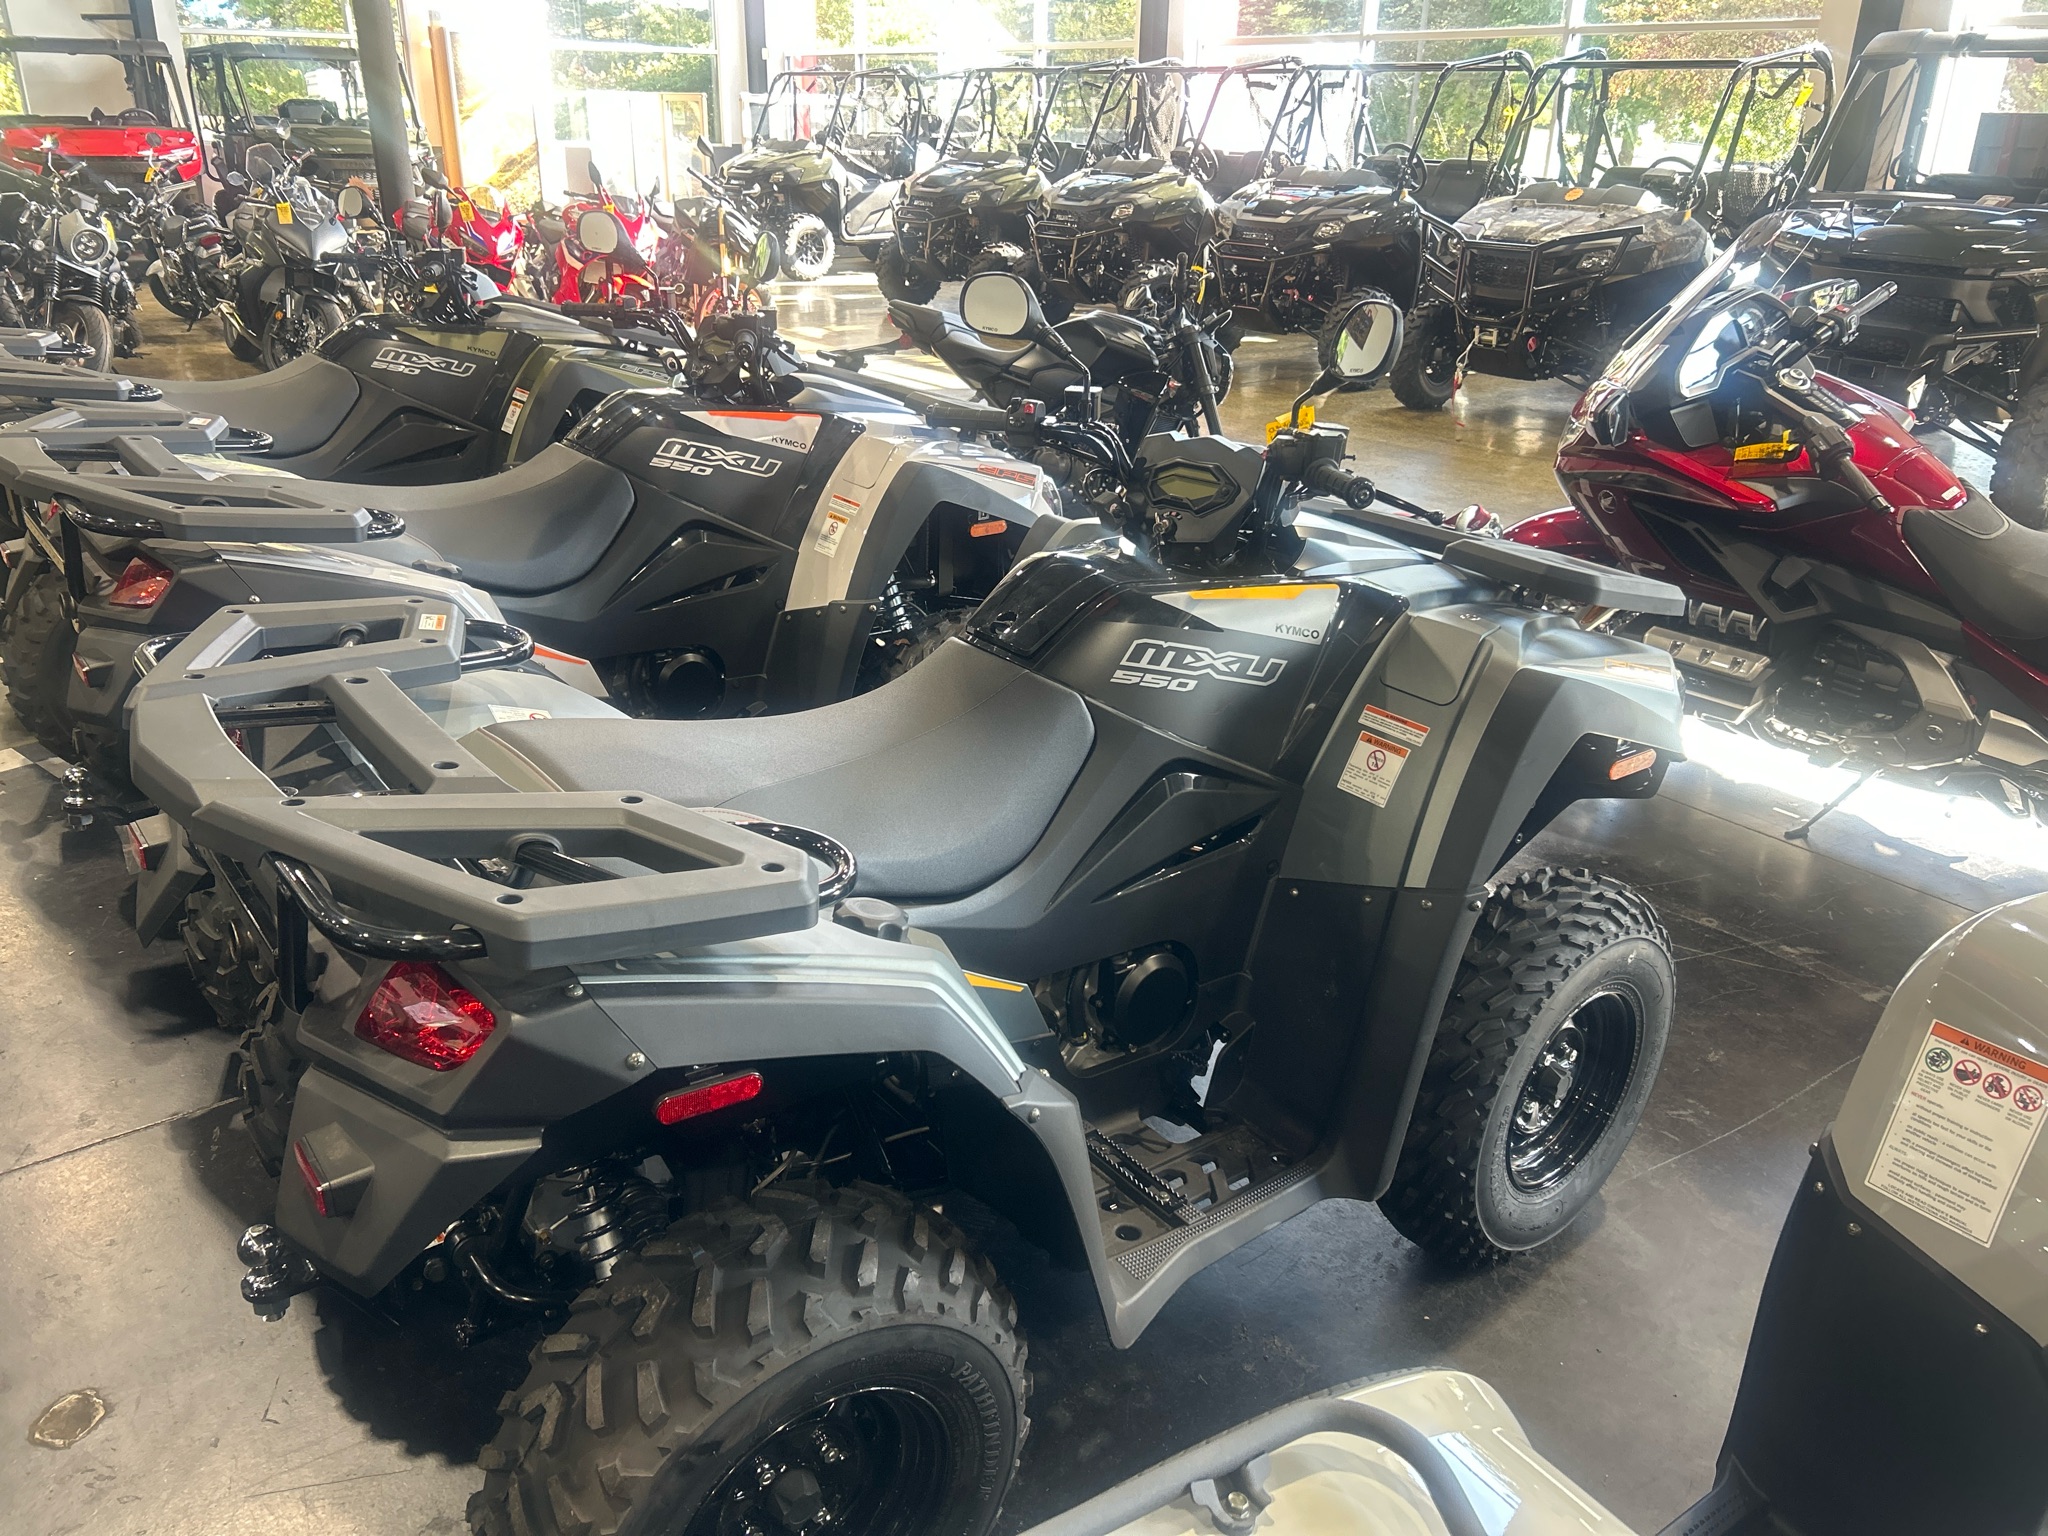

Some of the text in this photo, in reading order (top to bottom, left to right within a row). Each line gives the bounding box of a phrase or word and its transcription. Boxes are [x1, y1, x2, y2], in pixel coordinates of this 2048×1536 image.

[466, 345, 496, 357] KYMCO
[370, 361, 421, 375] 550
[771, 436, 807, 450] KYMCO
[649, 457, 714, 476] 550
[1275, 624, 1320, 640] KYMCO
[1110, 670, 1198, 692] 550
[1373, 739, 1401, 754] WARNING
[1972, 1040, 2027, 1070] WARNING
[951, 1361, 1002, 1501] PATHFINDER
